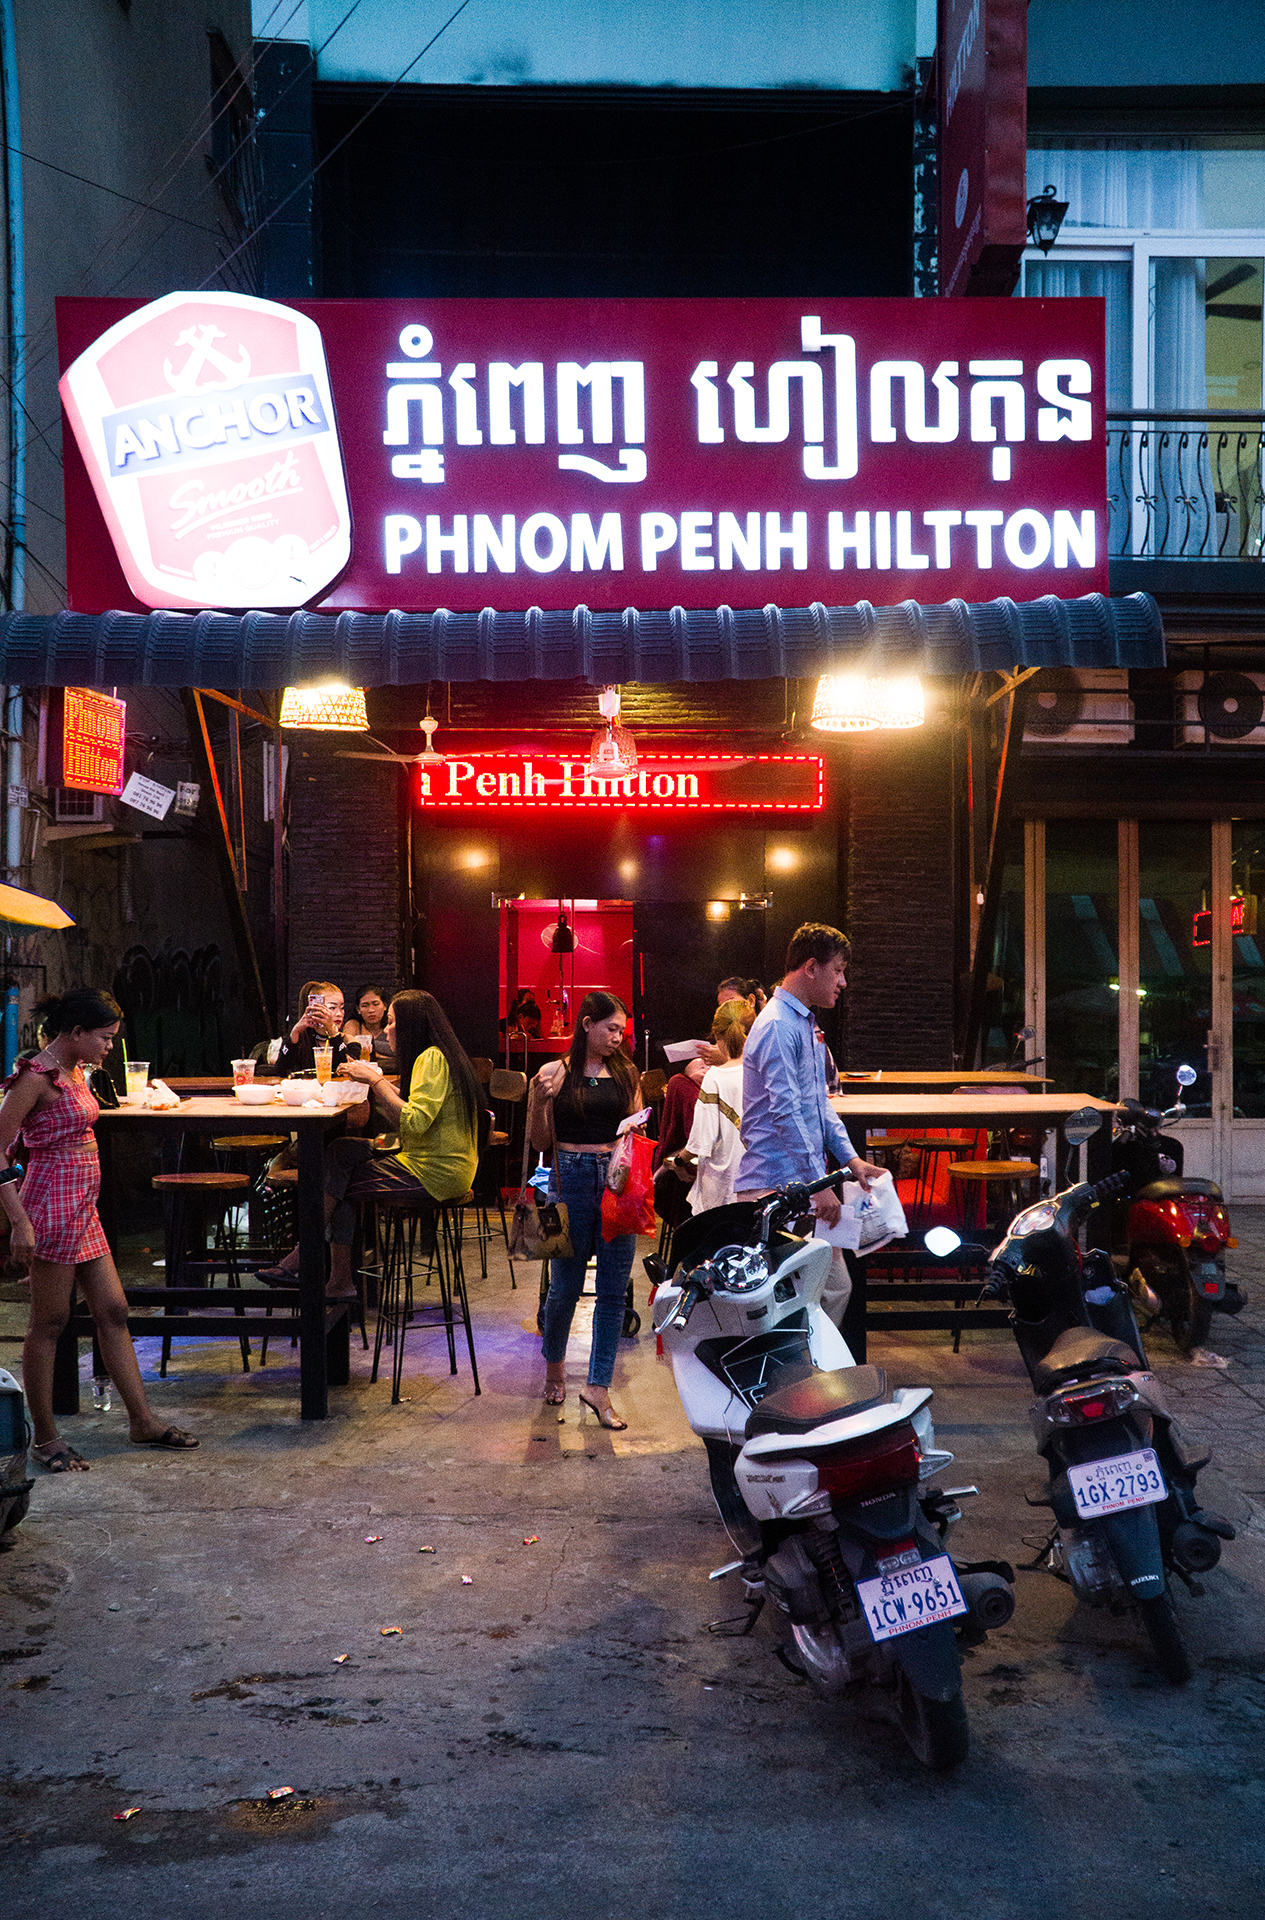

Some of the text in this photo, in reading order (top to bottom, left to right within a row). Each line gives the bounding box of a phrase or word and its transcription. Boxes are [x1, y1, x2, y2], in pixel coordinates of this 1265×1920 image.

[384, 324, 648, 484] ភ្នំពេញ
[115, 387, 322, 468] ANCHOR
[168, 450, 301, 531] Smooth
[206, 519, 281, 541] PREMIUM QUALITY
[384, 508, 1096, 574] PHNOM PENH HILTTON
[444, 761, 547, 797] Penh
[859, 1491, 897, 1509] HONDA
[1077, 1470, 1160, 1508] 1GX-2793
[1102, 1496, 1145, 1511] PHNOM PENH
[880, 1565, 934, 1597] ភ្នំពេញ
[1130, 1574, 1160, 1587] SUZUKI
[888, 1609, 952, 1636] PHNOM PENH
